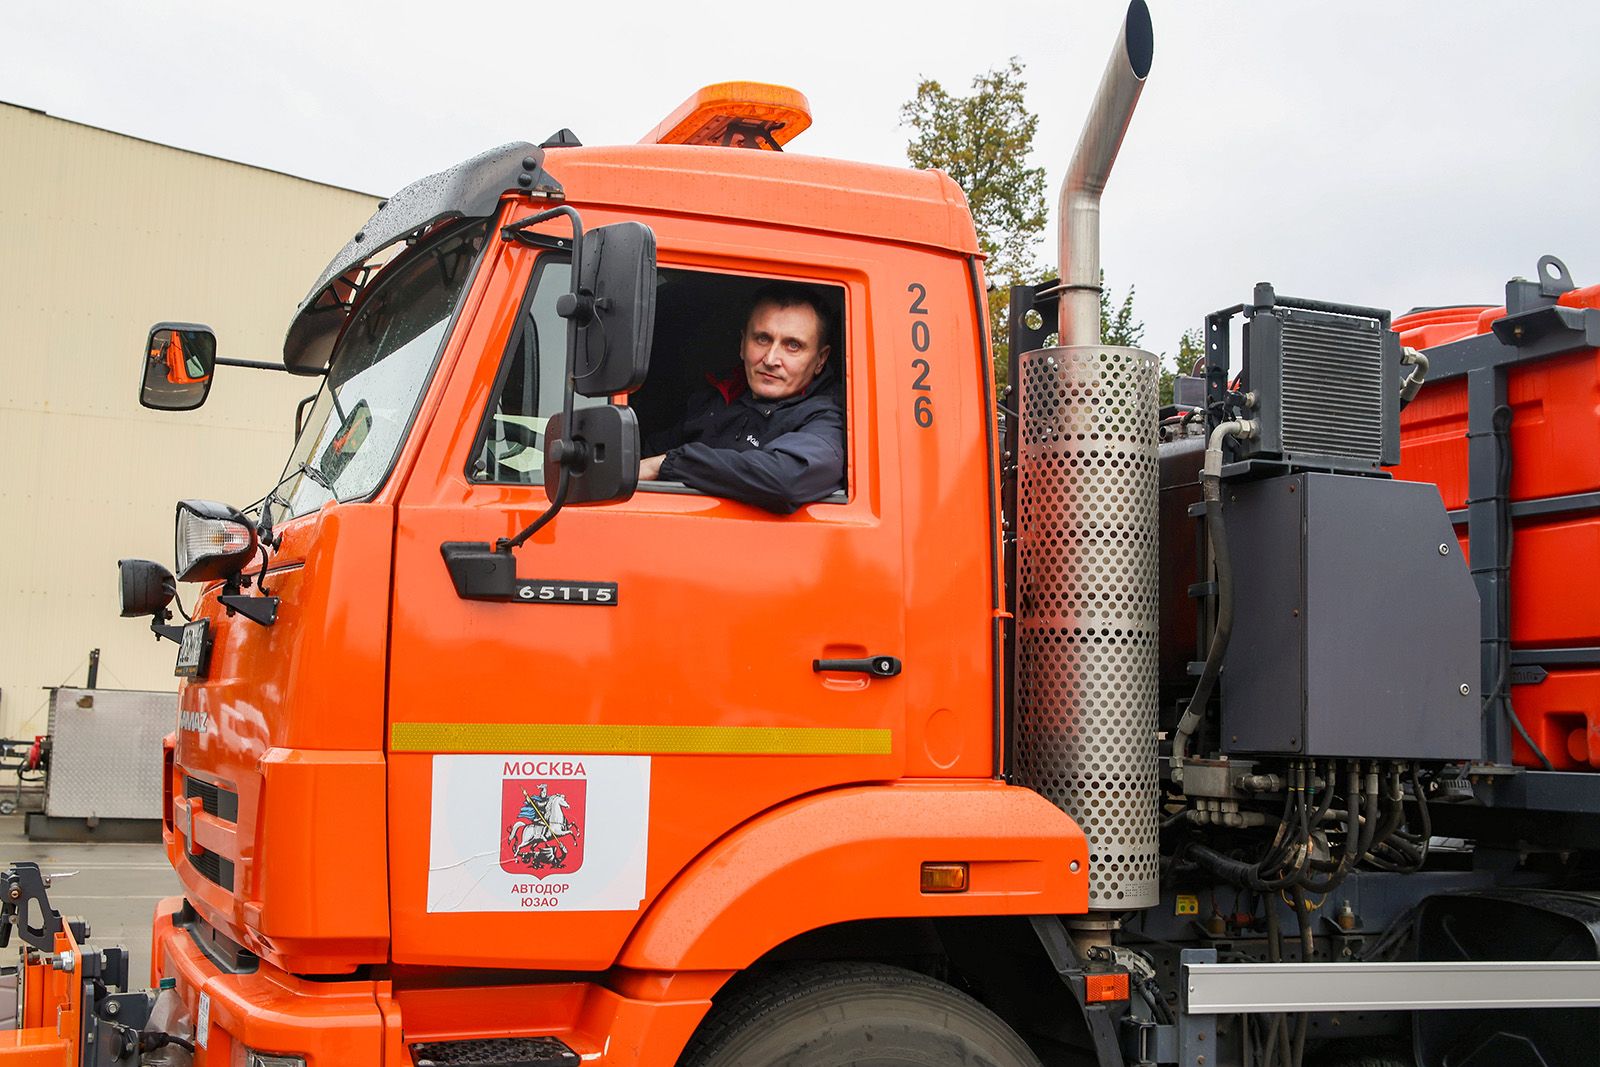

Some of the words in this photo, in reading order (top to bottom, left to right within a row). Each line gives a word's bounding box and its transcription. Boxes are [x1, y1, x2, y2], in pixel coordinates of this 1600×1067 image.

[907, 283, 934, 428] 2026
[519, 585, 612, 601] 65115
[503, 761, 586, 776] МОСКВА
[511, 883, 569, 894] АВТОДОР
[521, 897, 558, 907] ЮЗАО
